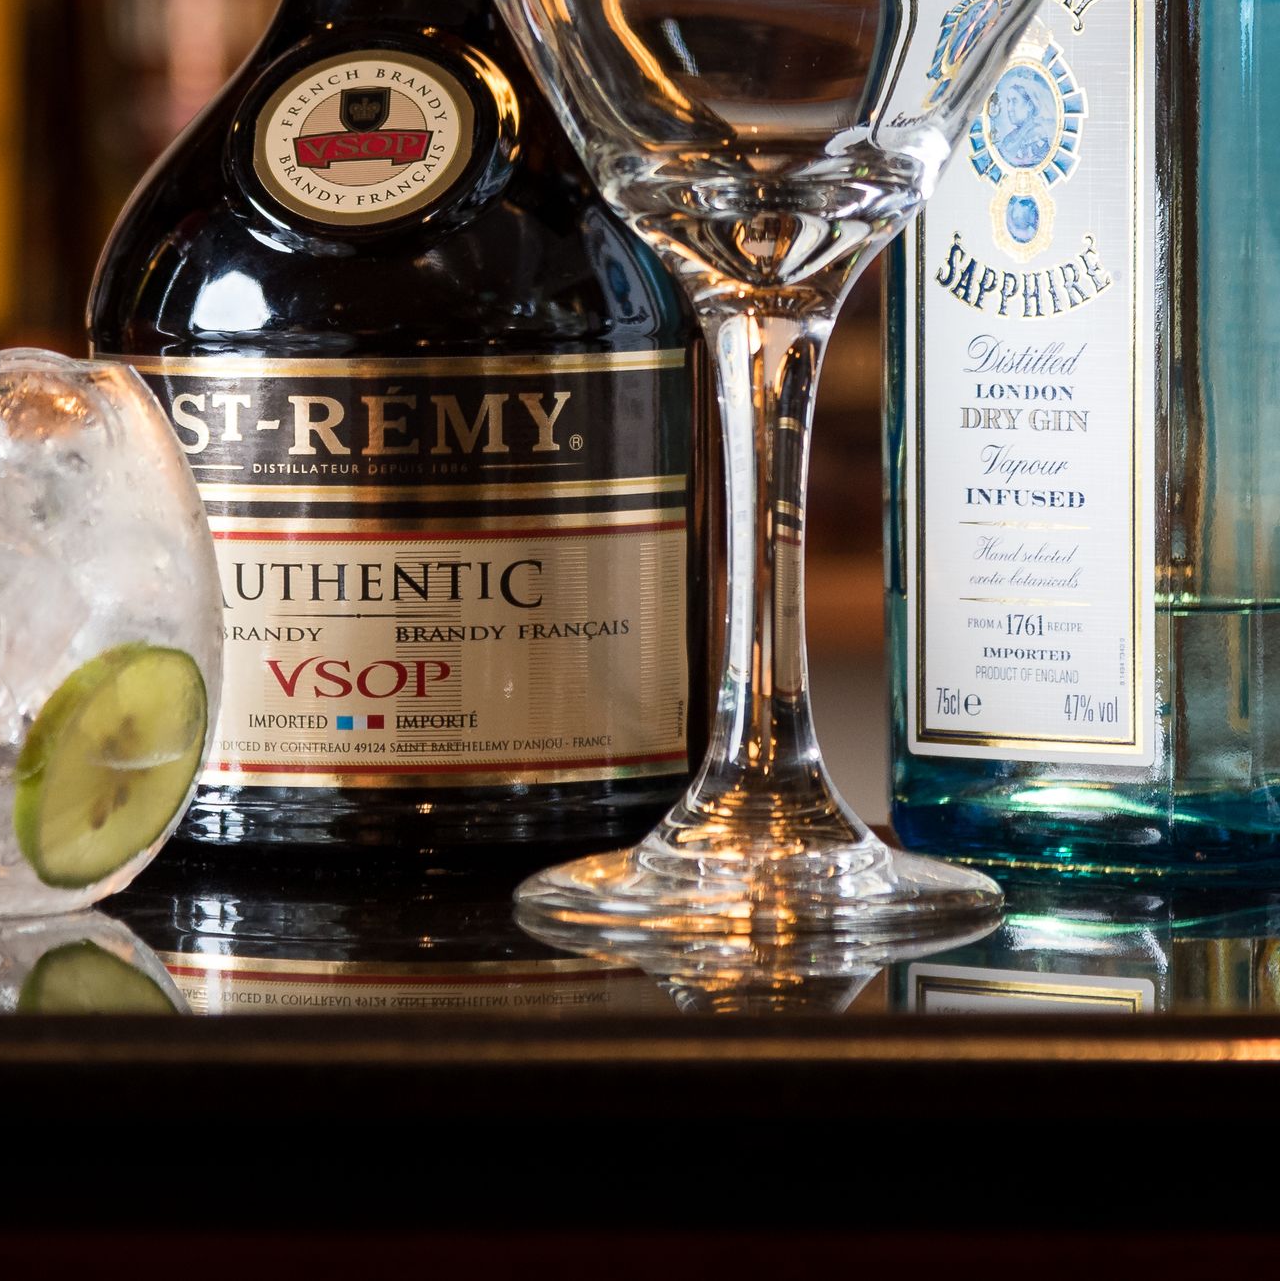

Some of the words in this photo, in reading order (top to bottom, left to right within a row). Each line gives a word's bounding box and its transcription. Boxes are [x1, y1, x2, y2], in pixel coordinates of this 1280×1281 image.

[280, 69, 360, 128] FRENCH
[376, 68, 447, 122] BRANDY
[303, 135, 419, 159] VSOP
[278, 155, 346, 206] BRANDY
[356, 144, 446, 206] FRANÇAIS
[936, 232, 1111, 318] SAPPHIRE
[963, 334, 1088, 375] Distilled
[975, 383, 1075, 401] LONDON
[172, 386, 571, 455] ST-RÉMY
[960, 406, 1023, 430] DRY
[1028, 409, 1091, 432] GIN
[252, 463, 360, 474] DISTILLATEUR
[981, 444, 1070, 483] Vapour
[964, 487, 1086, 509] INFUSED
[972, 535, 1023, 563] Hand
[1021, 544, 1079, 564] selected
[222, 560, 543, 609] UTHENTIC
[969, 570, 1008, 586] exotic
[1008, 567, 1082, 589] botanicals
[396, 624, 506, 642] BRANDY
[518, 619, 630, 640] FRANÇAIS
[967, 617, 995, 629] FROM
[996, 620, 1003, 630] A
[1005, 613, 1045, 636] 1761
[1047, 621, 1083, 633] RECIPE
[984, 646, 1072, 661] IMPORTED
[265, 655, 451, 699] VSOP
[975, 665, 1018, 681] PRODUCT
[1020, 667, 1033, 682] OF
[1035, 668, 1080, 684] ENGLAND
[935, 687, 961, 715] 75cl
[1063, 694, 1094, 722] 47%
[1098, 696, 1119, 723] vol
[248, 714, 328, 729] IMPORTED
[396, 711, 478, 729] IMPORTÉ
[264, 741, 278, 753] BY
[280, 741, 351, 753] COINTREAU
[354, 741, 386, 753] 49124
[390, 741, 426, 753] SAINT
[431, 740, 510, 752] BARTHELEMY
[513, 739, 563, 752] D'ANJOU
[572, 736, 612, 748] FRANCE
